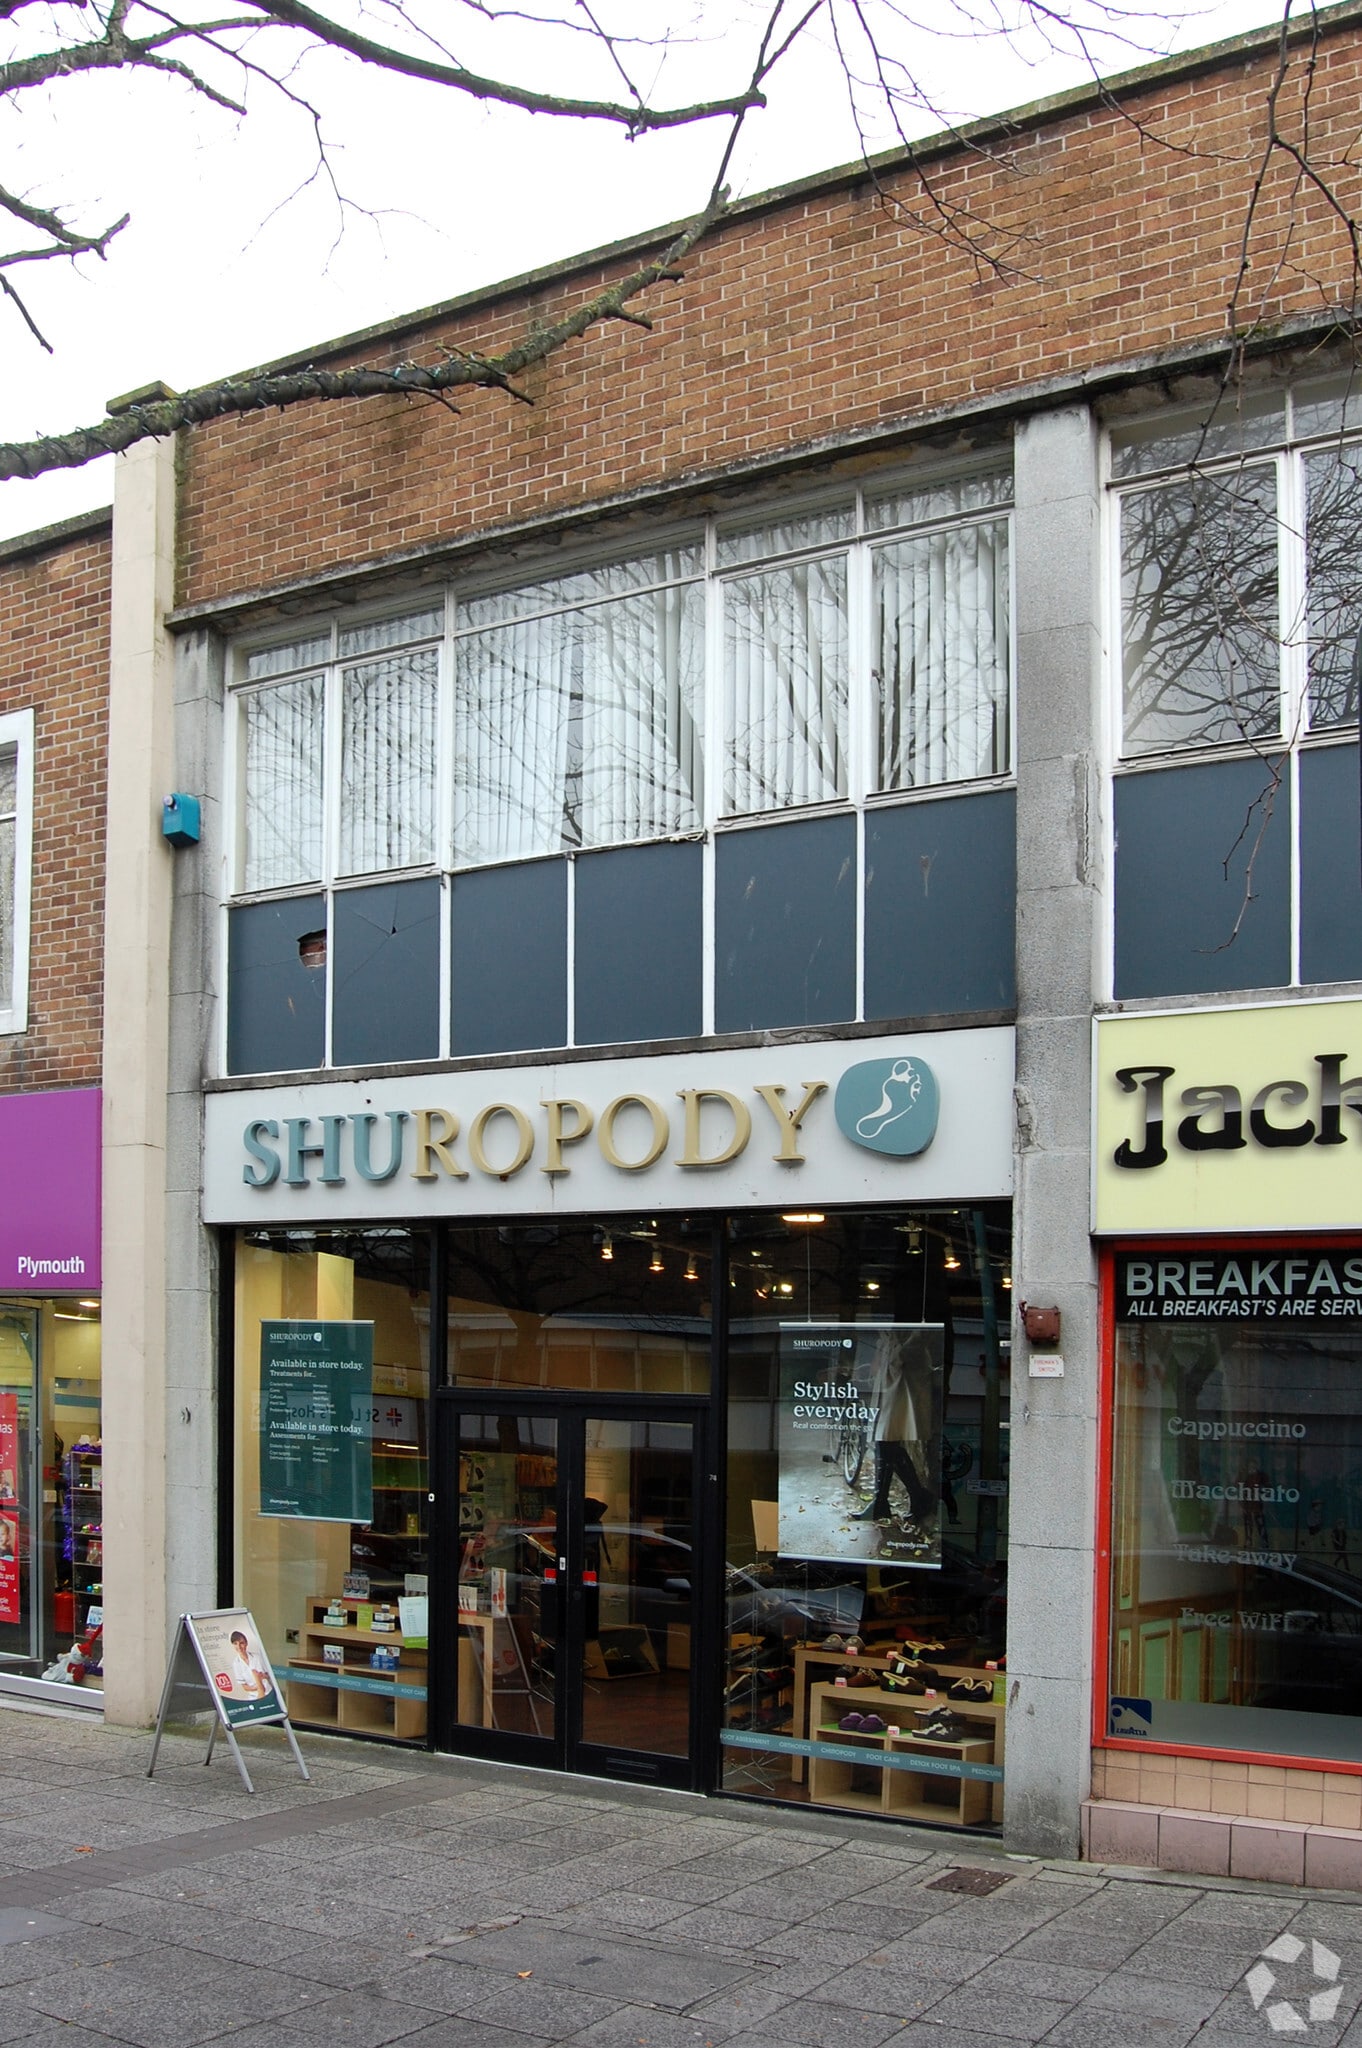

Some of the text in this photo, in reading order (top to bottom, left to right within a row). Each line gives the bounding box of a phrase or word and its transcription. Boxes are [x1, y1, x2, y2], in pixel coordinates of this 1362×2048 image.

[243, 1081, 829, 1187] SHUROPODY
[17, 1255, 86, 1278] Plymouth
[1127, 1300, 1158, 1317] ALL
[1162, 1299, 1277, 1317] BREAKFAST'S
[1279, 1299, 1316, 1316] ARE
[269, 1332, 312, 1341] SHUROPODY
[793, 1339, 842, 1348] SHUROPODY
[270, 1359, 364, 1371] Available in store today.
[270, 1369, 303, 1377] Treatments
[793, 1382, 859, 1400] Stylish
[793, 1404, 880, 1422] everyday
[270, 1421, 364, 1434] Available in store today.
[793, 1421, 809, 1429] Real
[1167, 1416, 1306, 1440] Cappuccino
[270, 1431, 306, 1440] Assessments
[1171, 1480, 1300, 1502] Macchiato
[1181, 1607, 1231, 1627] Free
[779, 1741, 812, 1751] ORTHOTICS
[821, 1747, 856, 1757] CHIROPODY
[866, 1753, 900, 1763] FOOT CARE
[910, 1759, 930, 1767] DETOX
